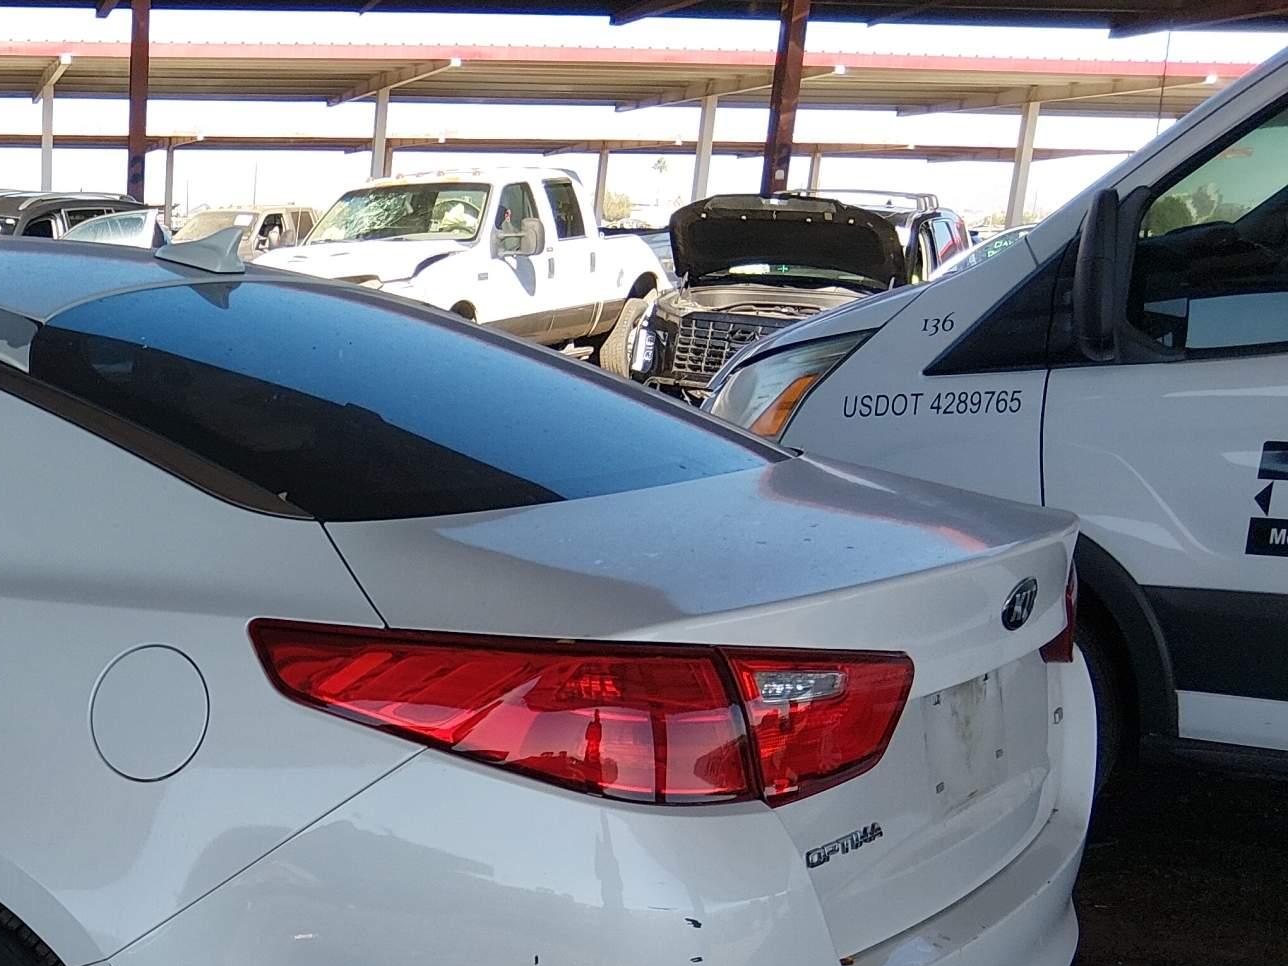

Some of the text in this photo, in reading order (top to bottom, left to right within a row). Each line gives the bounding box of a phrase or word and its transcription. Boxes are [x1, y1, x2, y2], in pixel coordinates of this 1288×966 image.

[921, 311, 956, 337] 136
[843, 390, 1023, 418] USDOT 4289765
[805, 821, 883, 869] OPTIMA
